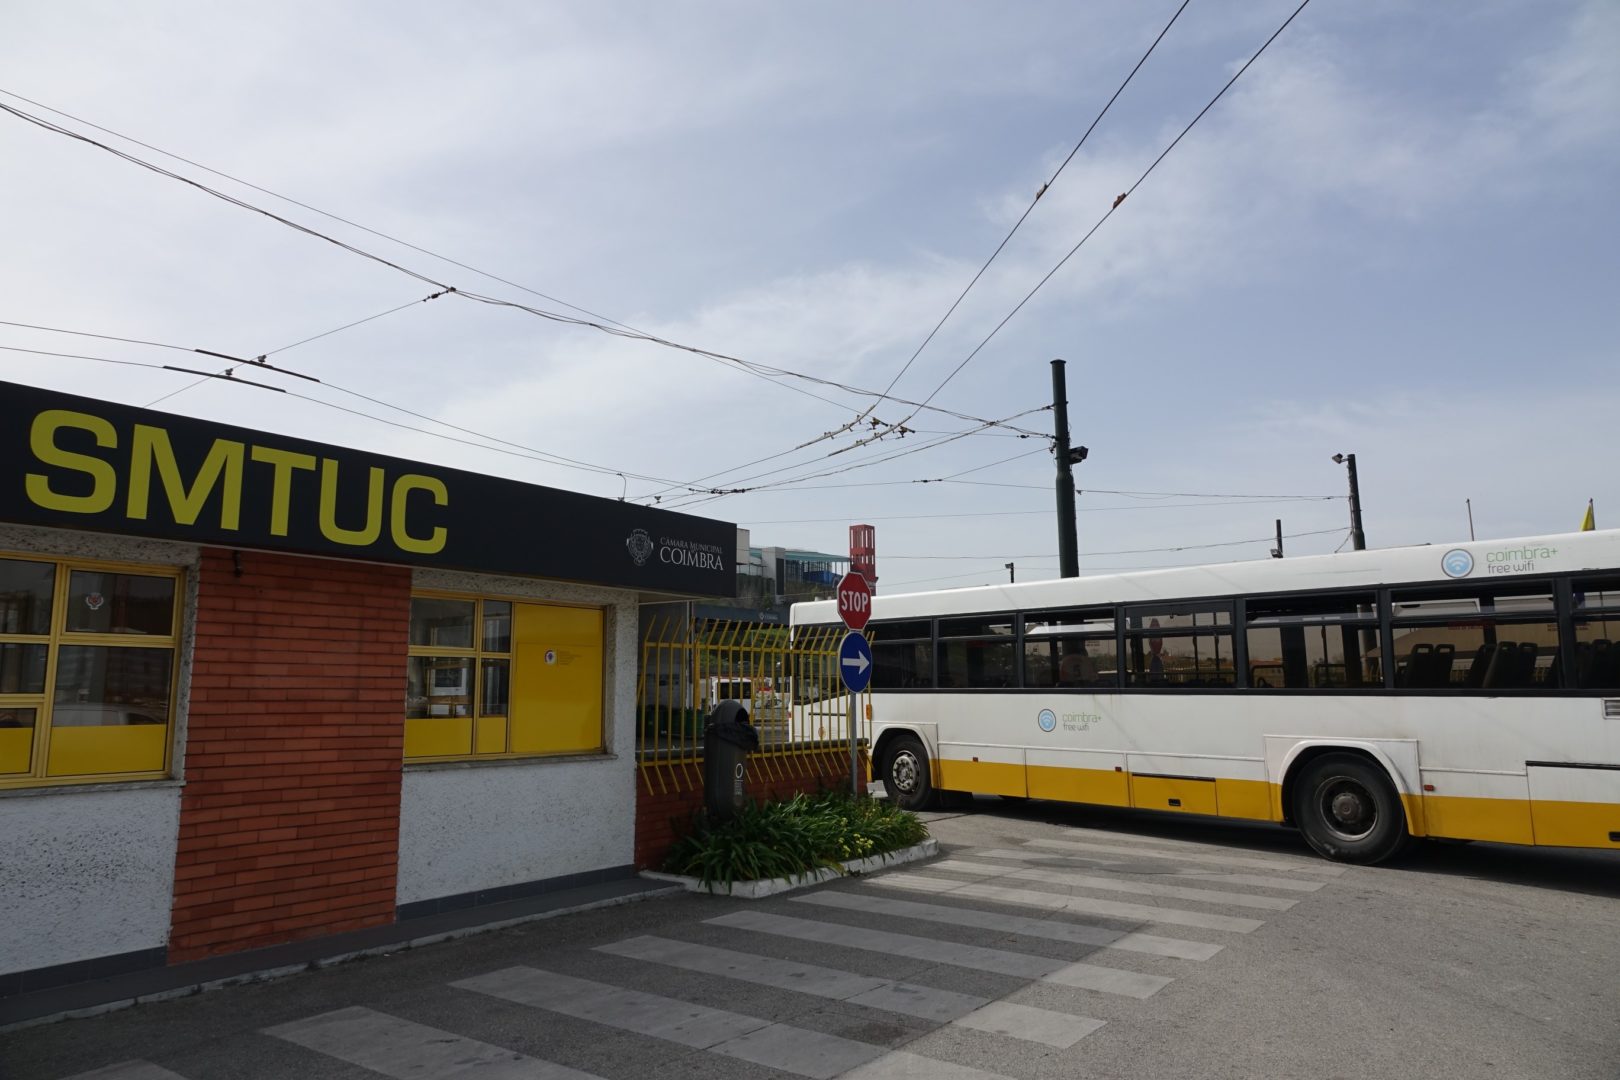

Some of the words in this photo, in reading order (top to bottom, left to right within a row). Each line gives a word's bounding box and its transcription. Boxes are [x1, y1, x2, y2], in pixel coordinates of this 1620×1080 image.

[25, 409, 449, 554] SMTUC
[690, 541, 723, 554] MUNICIPAL
[1486, 545, 1558, 563] coimbra+
[660, 546, 724, 571] COIMBRA
[1488, 562, 1511, 574] free
[1513, 560, 1535, 573] wifi
[841, 590, 869, 612] STOP
[1063, 722, 1076, 731] free
[1077, 722, 1090, 731] wifi
